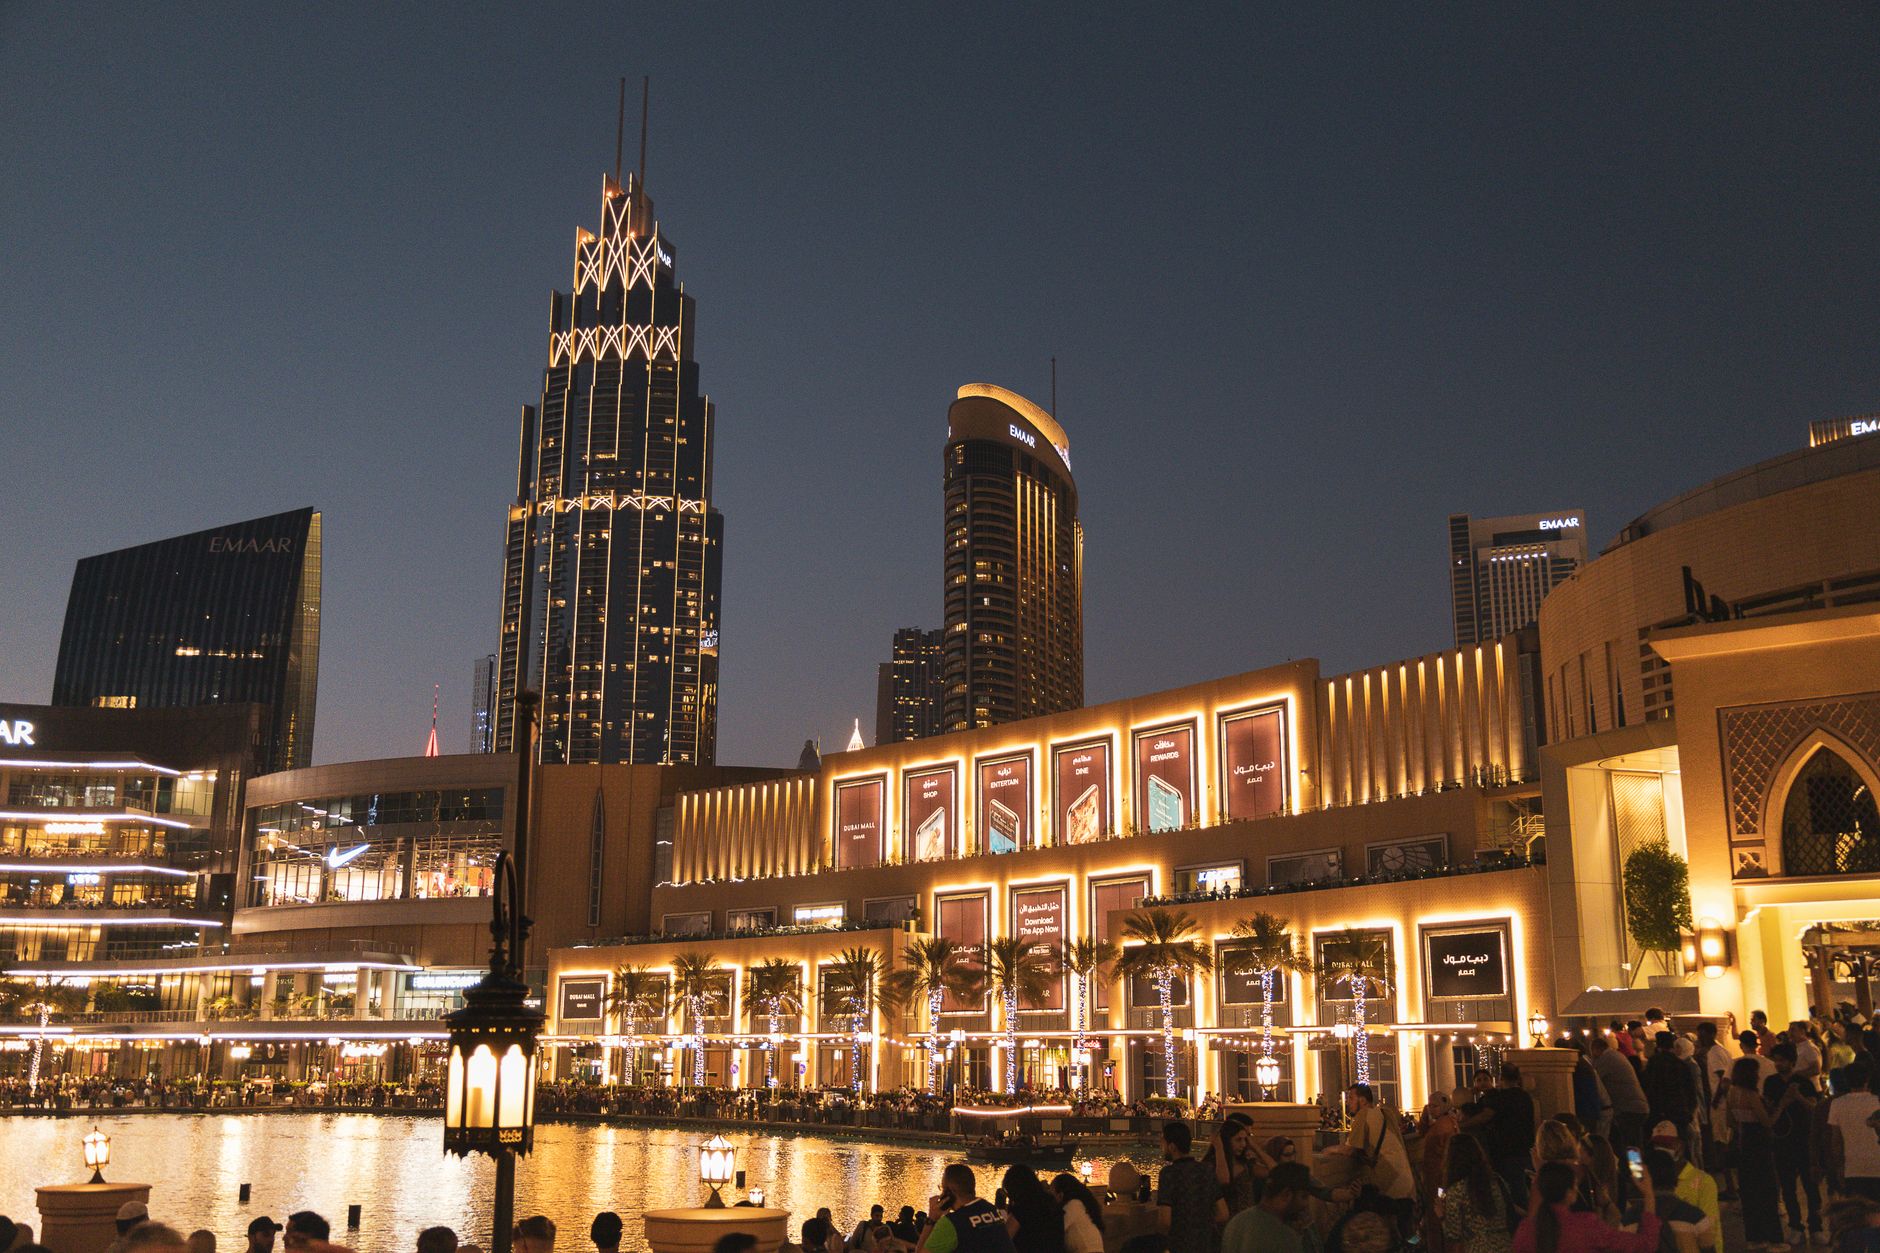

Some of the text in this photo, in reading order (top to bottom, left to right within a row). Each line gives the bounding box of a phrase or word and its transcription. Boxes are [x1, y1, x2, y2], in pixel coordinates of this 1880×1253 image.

[1851, 419, 1880, 436] EM
[1009, 424, 1035, 449] EMAAR
[1539, 517, 1580, 530] EMAAR
[209, 536, 292, 553] EMAAR
[1150, 751, 1179, 763] REWARDS
[1075, 767, 1089, 775] DINE
[990, 778, 1019, 789] ENTERTAIN
[923, 791, 938, 799] SHOP
[843, 821, 876, 832] DUBAI MALL
[1025, 916, 1054, 926] Download
[1020, 925, 1059, 936] The App Now
[1443, 953, 1489, 965] دبي مول
